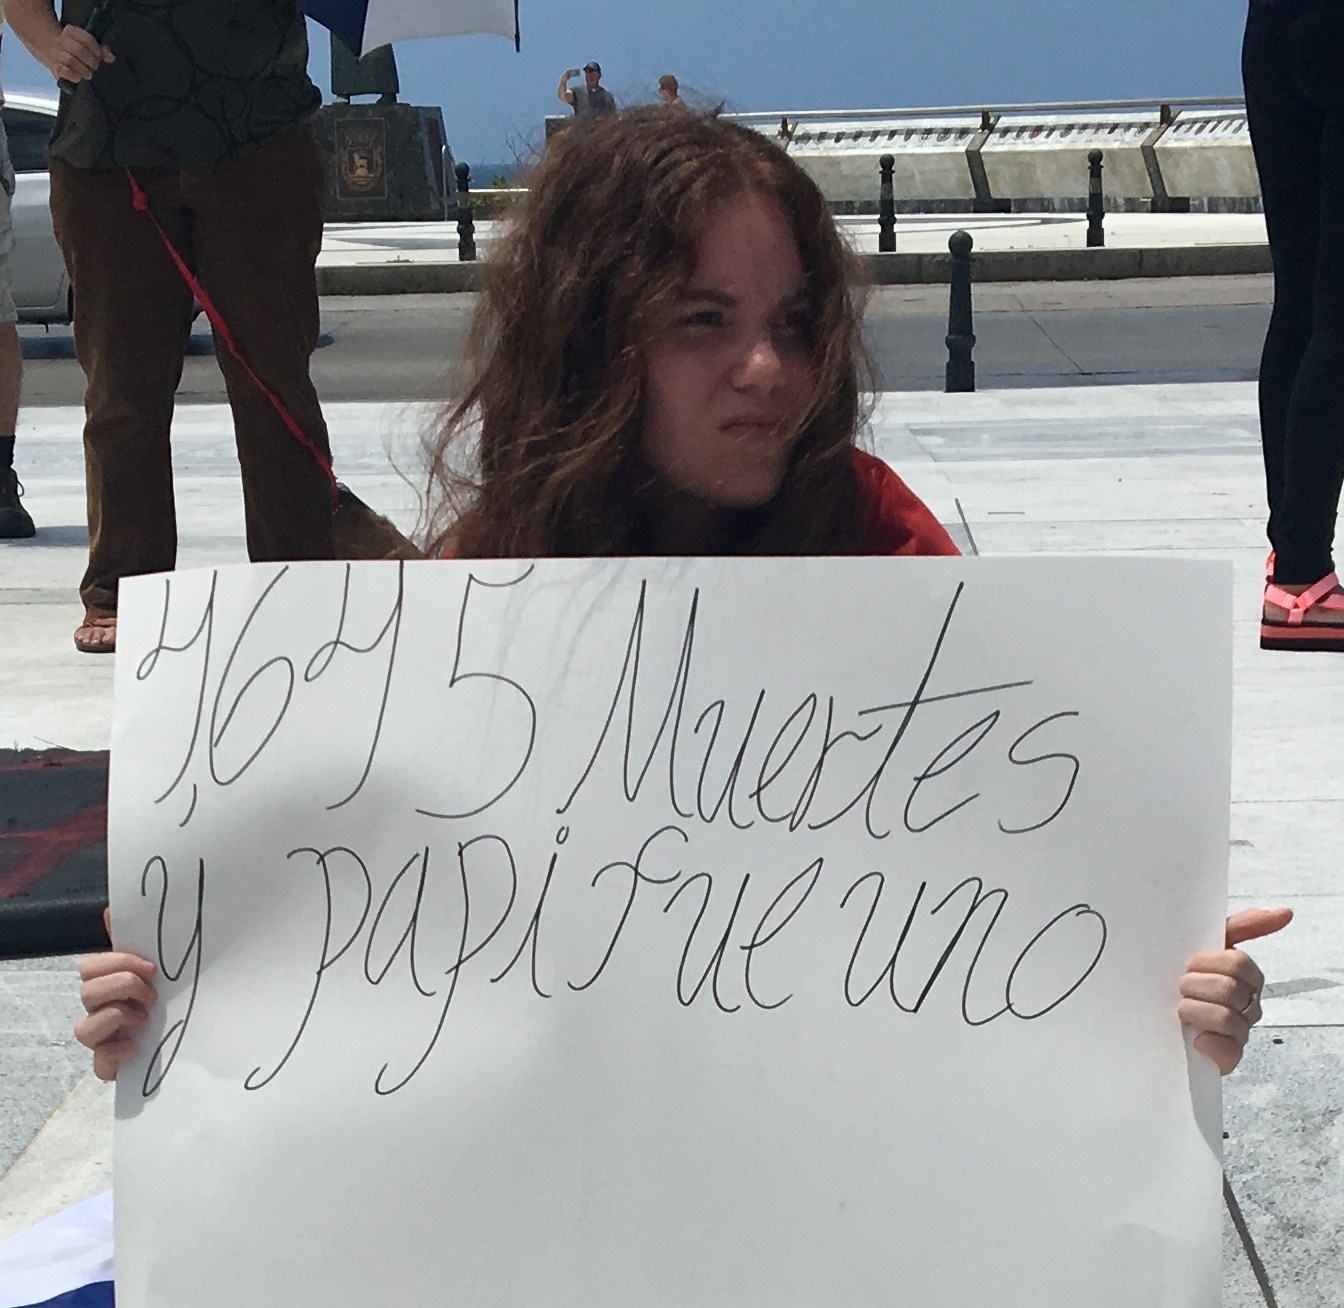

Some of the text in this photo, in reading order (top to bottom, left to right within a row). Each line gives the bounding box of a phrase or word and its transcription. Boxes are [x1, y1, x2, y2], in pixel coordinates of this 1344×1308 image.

[555, 578, 1080, 839] Muertes
[141, 825, 1108, 1097] y papi fue uno
